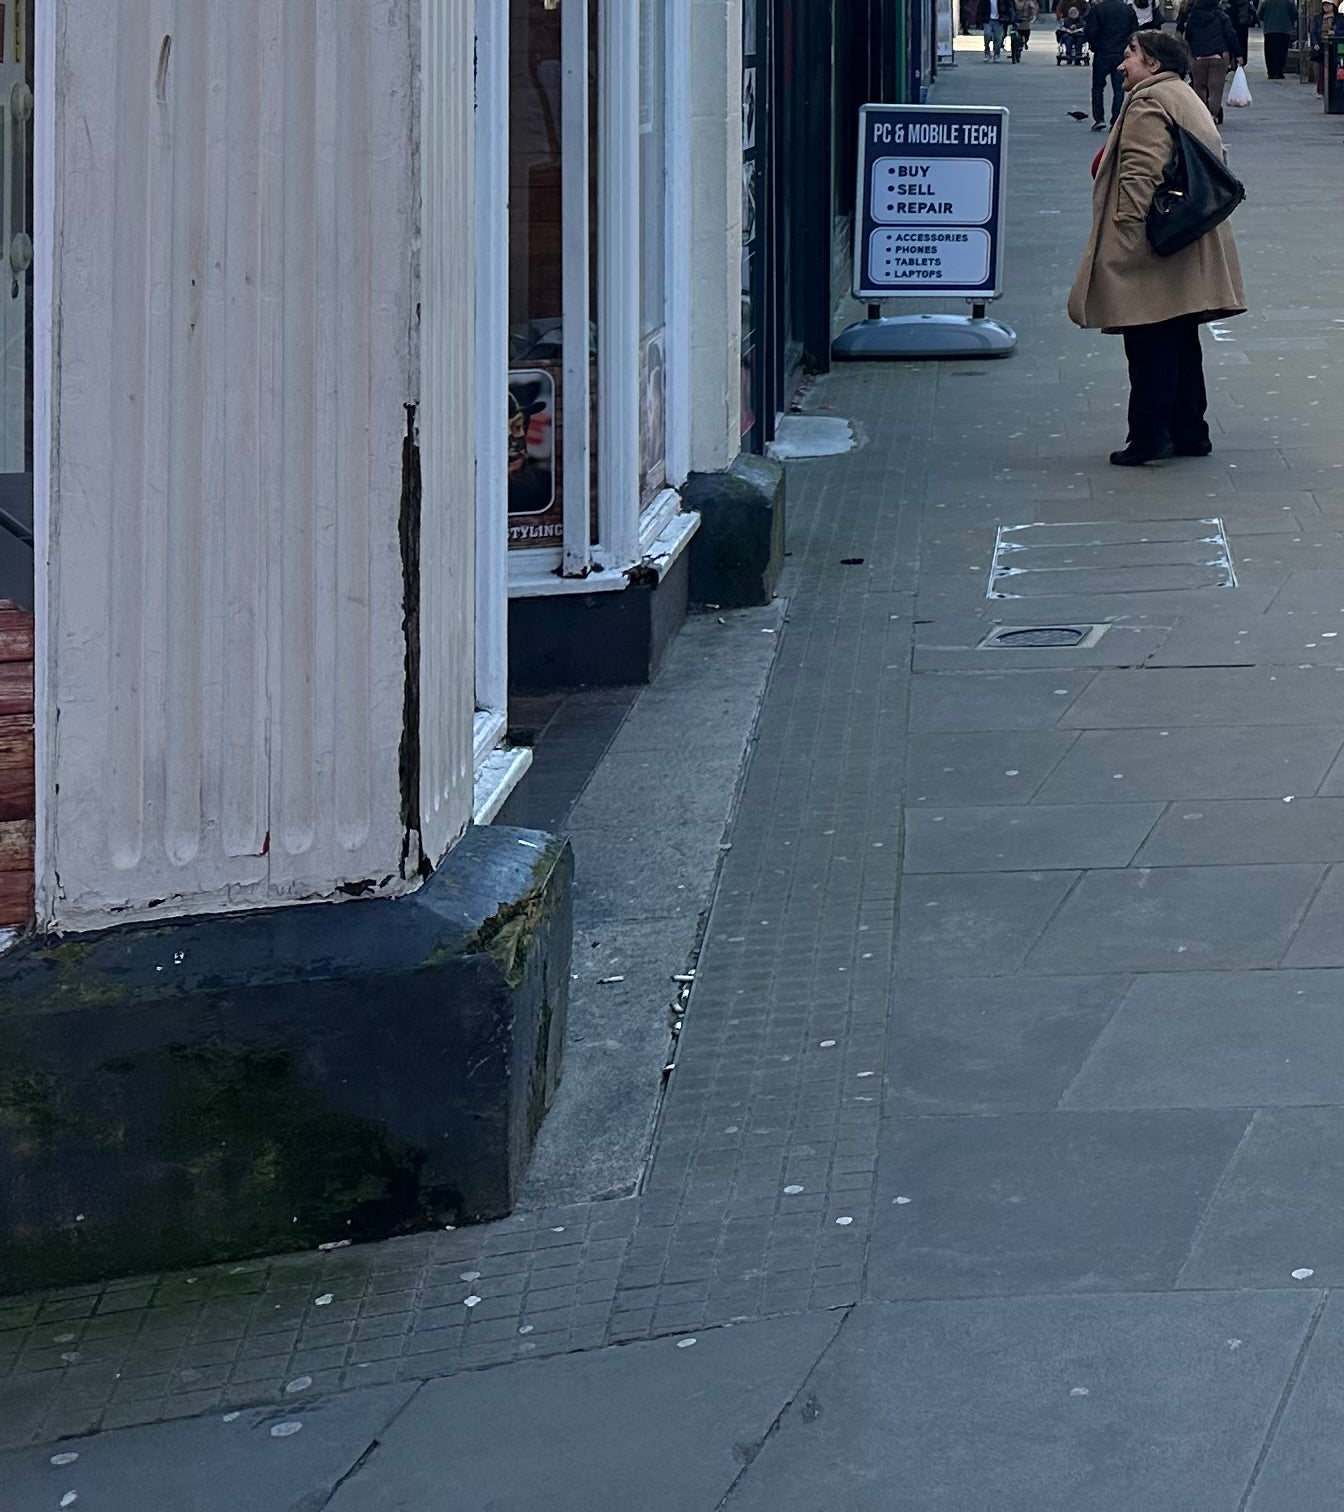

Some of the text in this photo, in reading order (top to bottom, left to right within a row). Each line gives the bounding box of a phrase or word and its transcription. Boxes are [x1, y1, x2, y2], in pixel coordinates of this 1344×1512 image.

[873, 123, 997, 145] PC & MOBILE TECH
[897, 166, 930, 177] BUY
[897, 184, 935, 196] SELL
[896, 202, 953, 214] REPAIR
[896, 233, 968, 242] ACCESSORIES
[895, 246, 937, 254] PHONES
[895, 258, 941, 266] TABLETS
[894, 270, 943, 278] LAPTOPS
